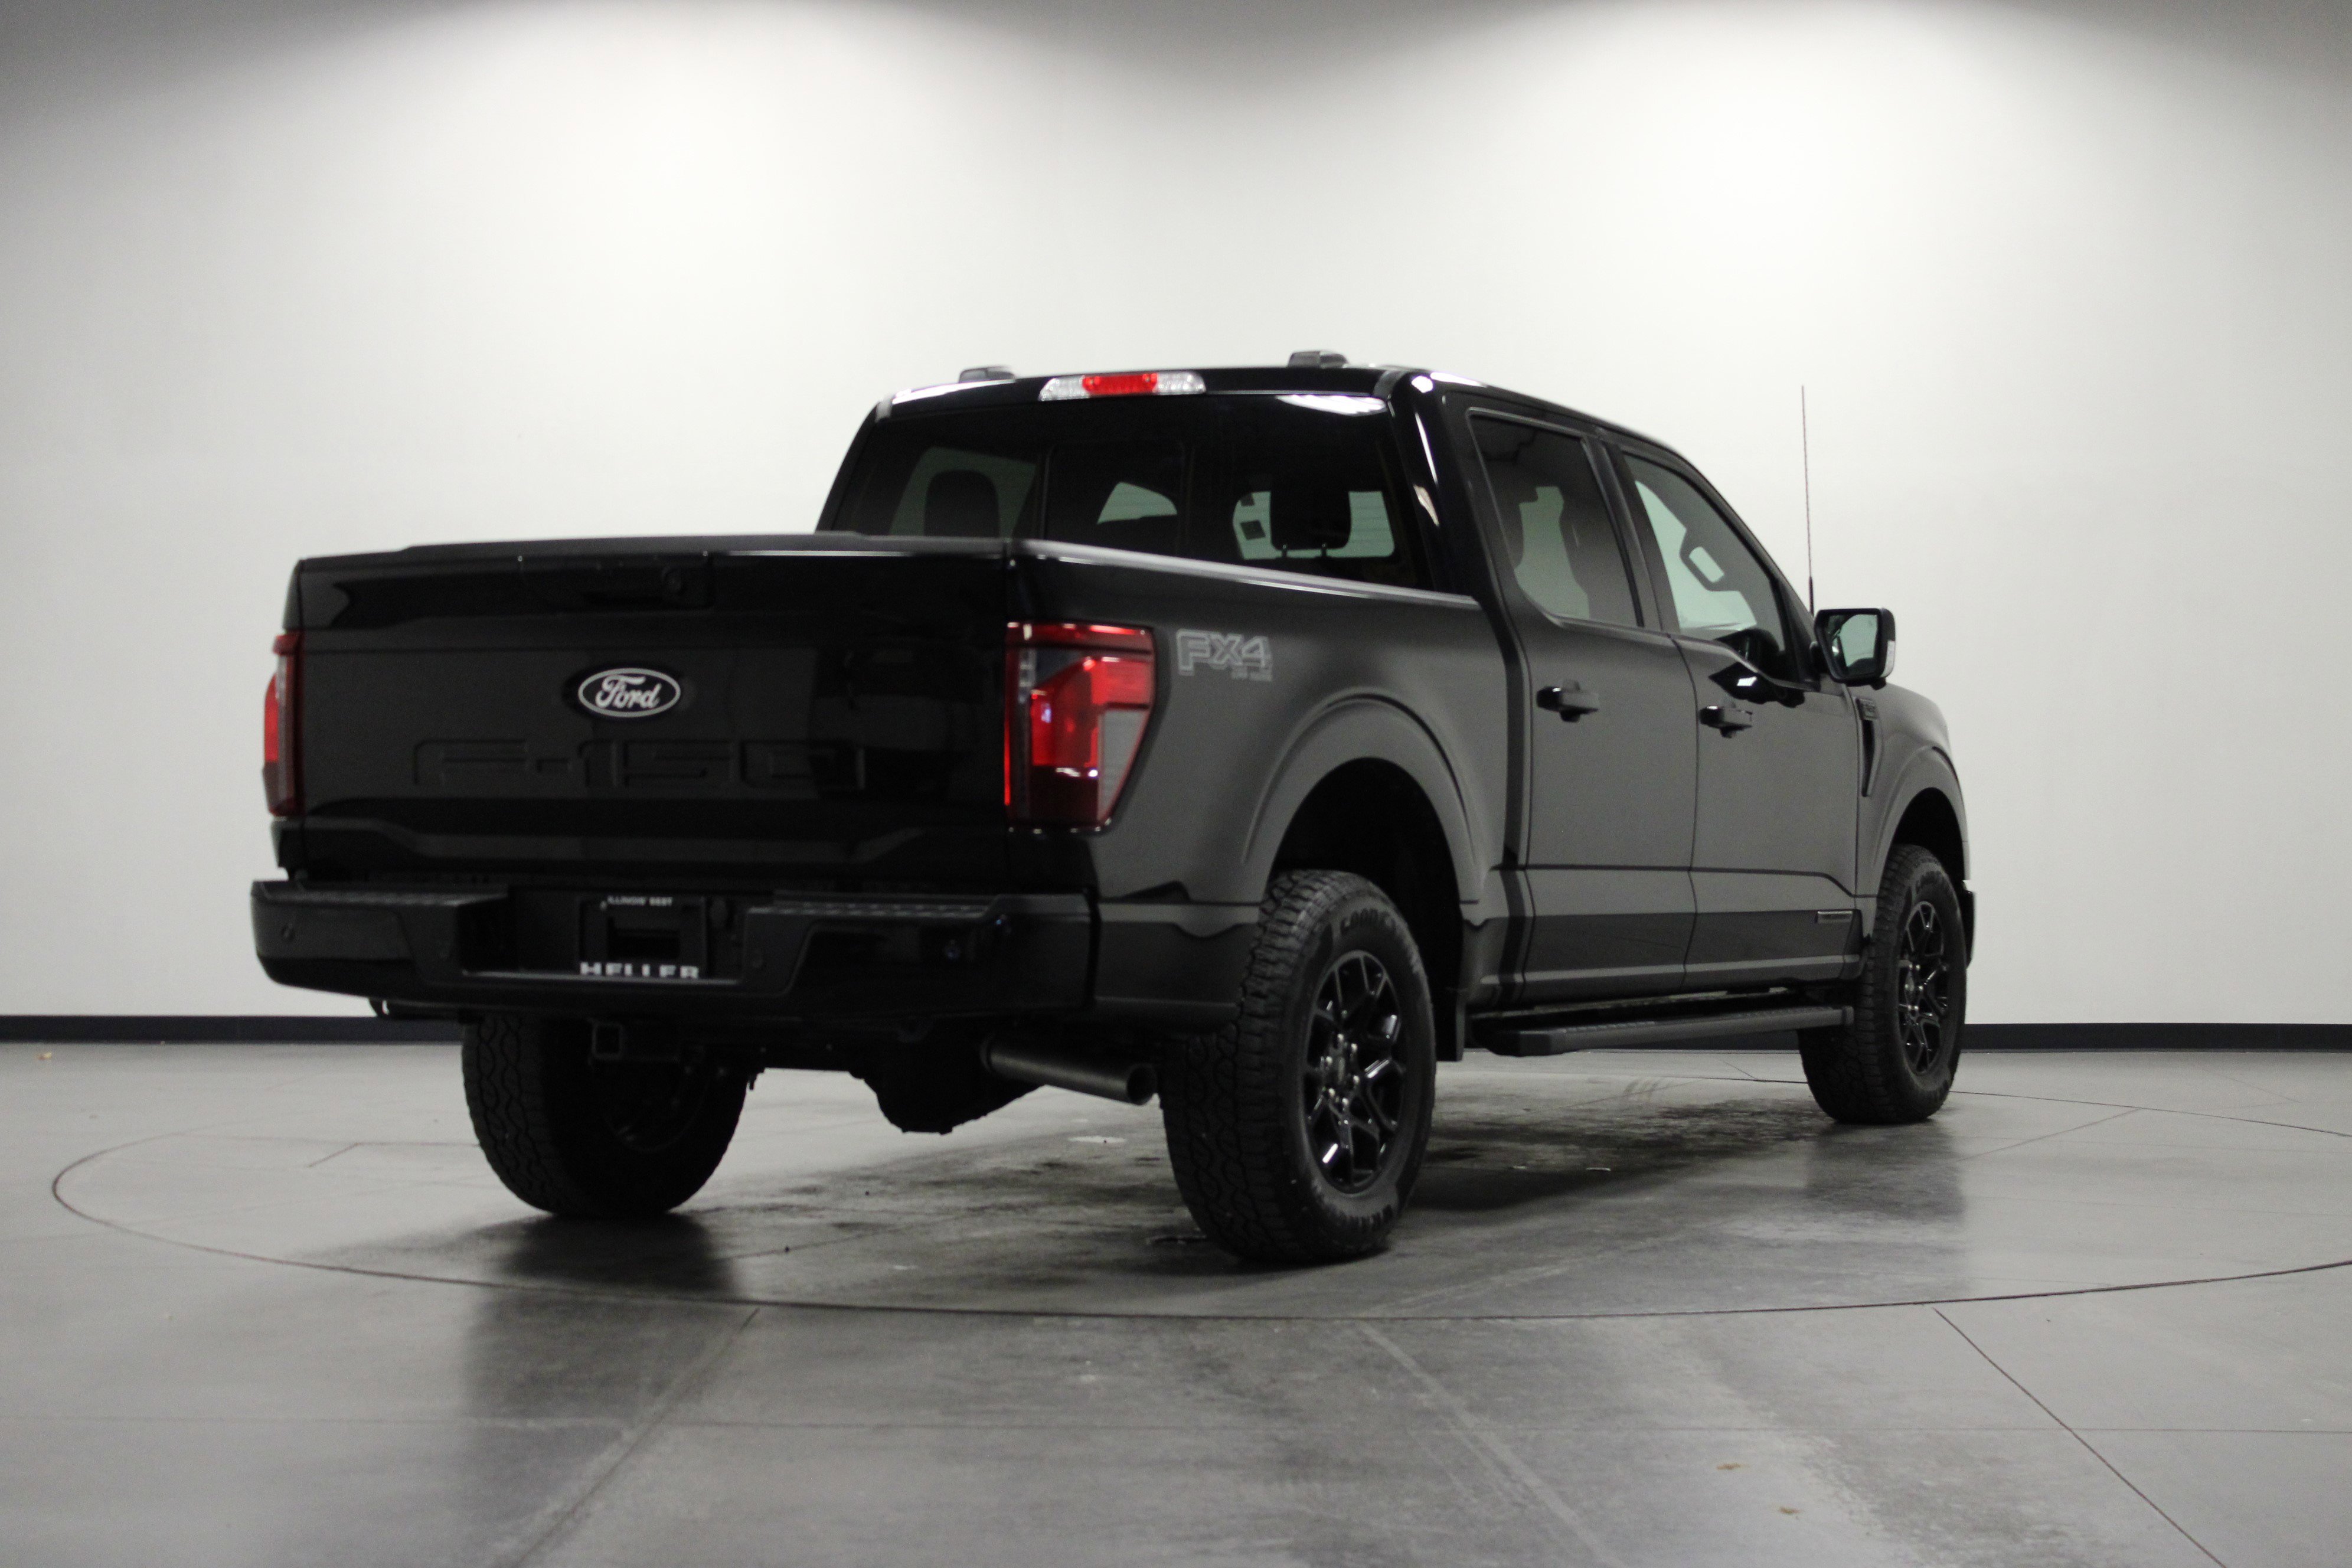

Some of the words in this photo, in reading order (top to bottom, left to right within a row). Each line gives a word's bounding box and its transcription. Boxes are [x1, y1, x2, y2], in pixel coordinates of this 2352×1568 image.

[1176, 628, 1272, 682] FX4
[595, 674, 662, 708] Ford
[413, 739, 865, 790] F-150
